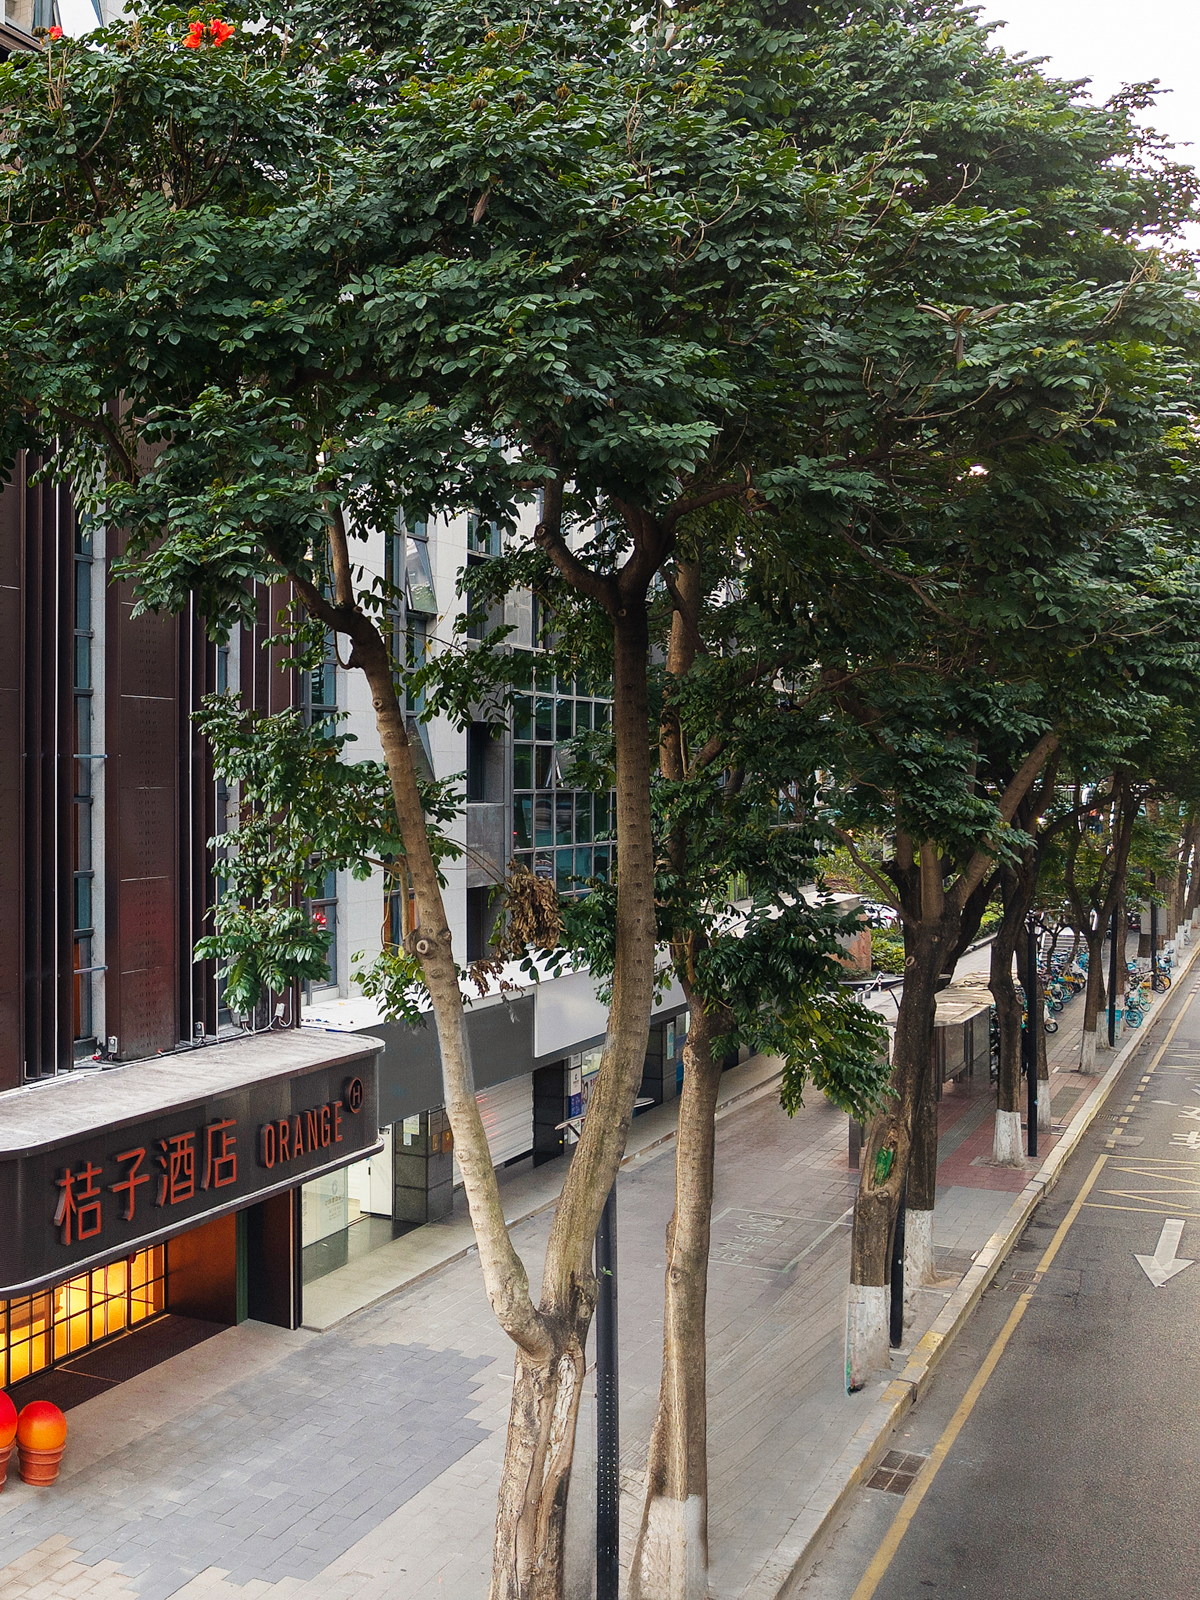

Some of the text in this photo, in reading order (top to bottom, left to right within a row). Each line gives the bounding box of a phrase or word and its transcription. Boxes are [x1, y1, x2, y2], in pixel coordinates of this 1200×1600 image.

[55, 1119, 237, 1245] 桔子酒店
[260, 1100, 343, 1168] ORANGE
